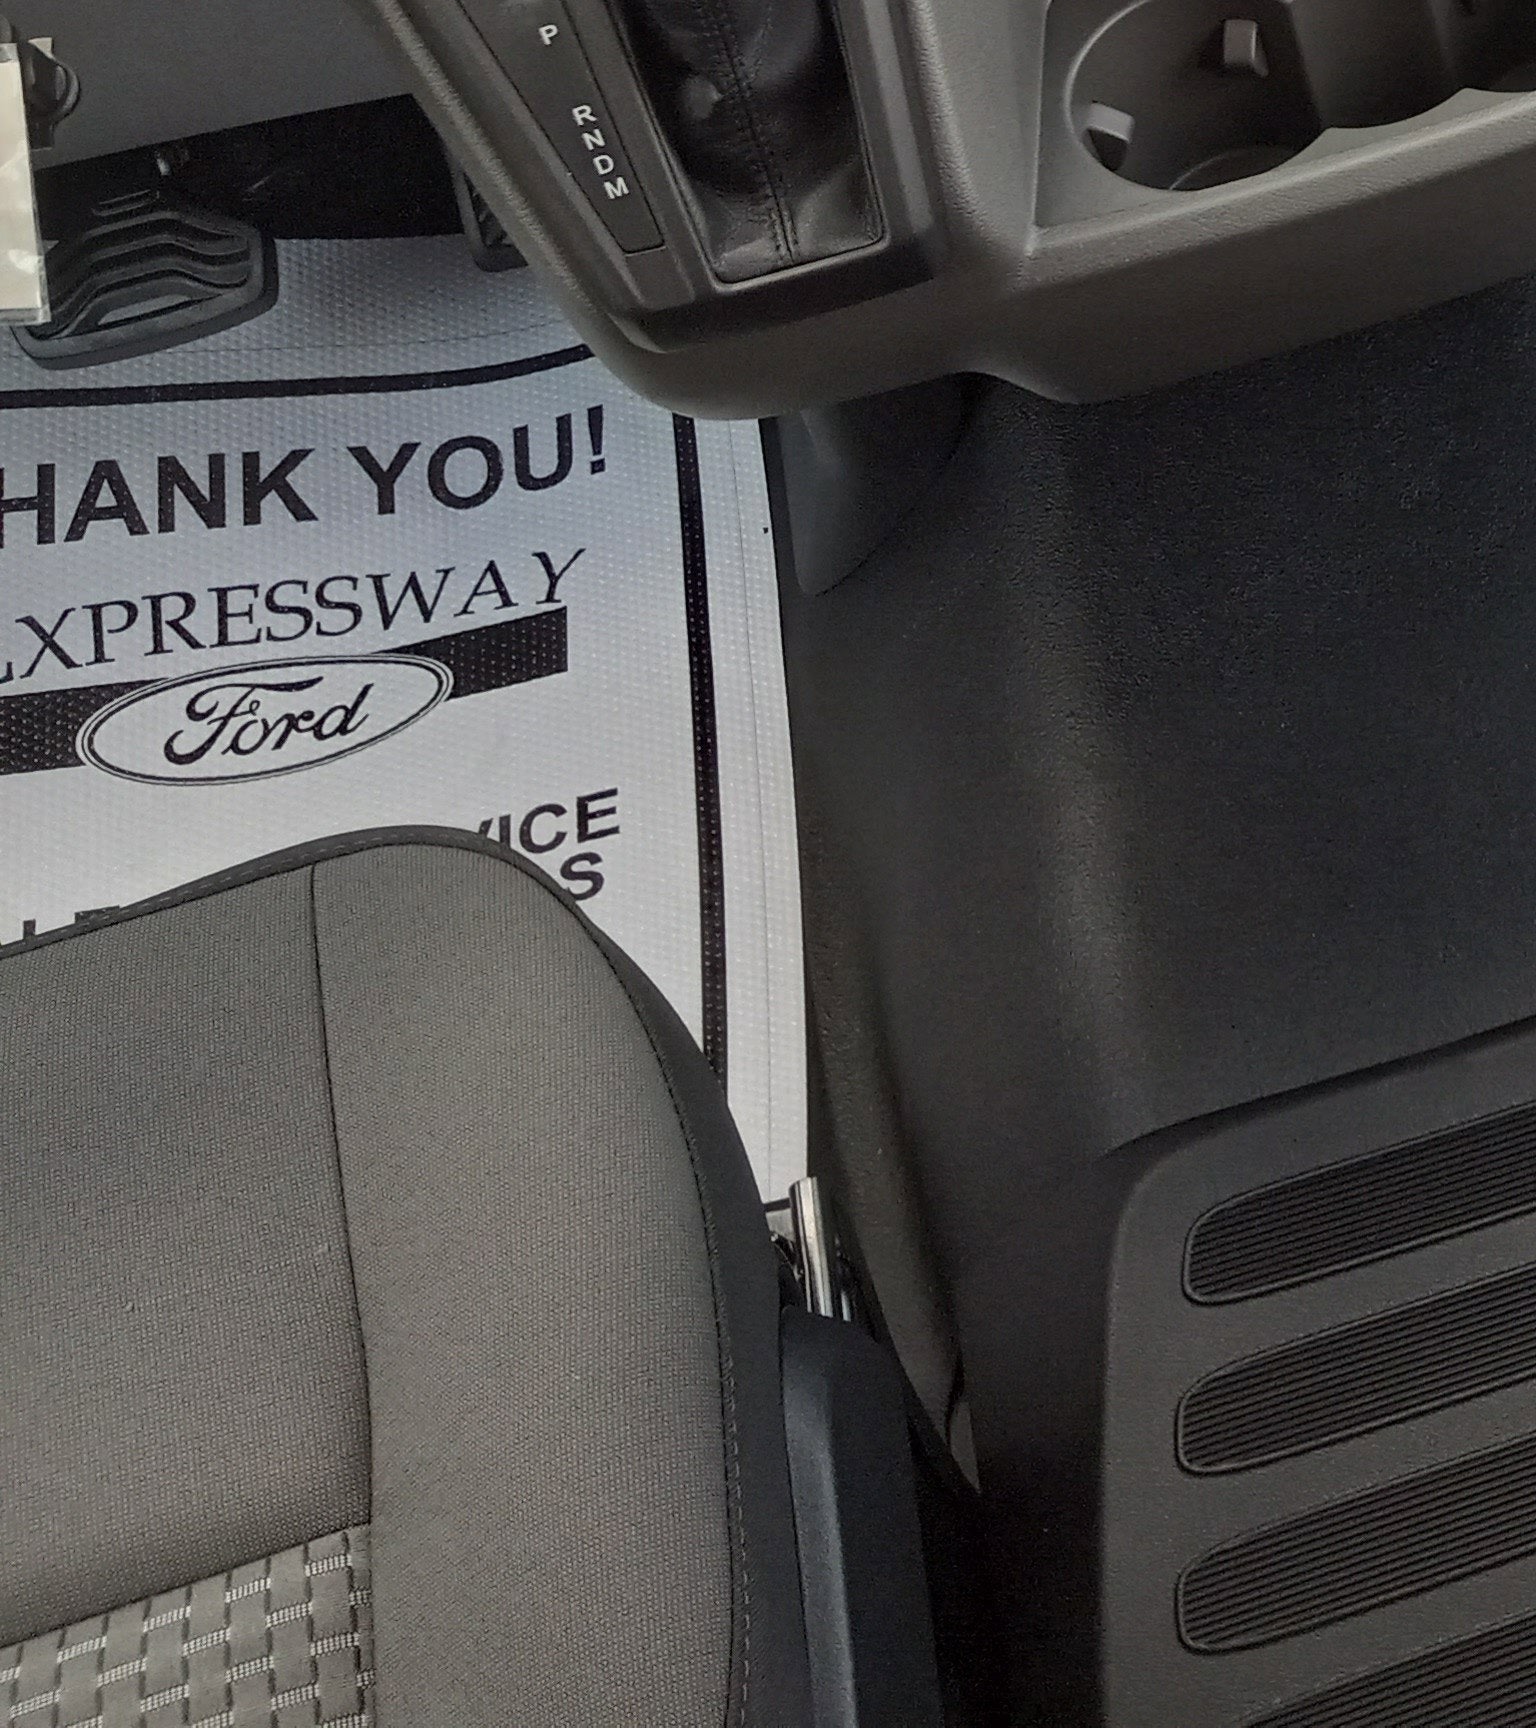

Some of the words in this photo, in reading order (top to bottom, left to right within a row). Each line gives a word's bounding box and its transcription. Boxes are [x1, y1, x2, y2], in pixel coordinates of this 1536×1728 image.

[538, 24, 558, 46] P
[571, 104, 598, 126] R
[581, 128, 606, 151] N
[592, 154, 615, 176] D
[603, 176, 630, 200] M
[0, 446, 317, 551] HANK
[347, 403, 609, 518] YOU!
[0, 547, 587, 686] XPRESSWAY
[162, 676, 376, 767] Ford
